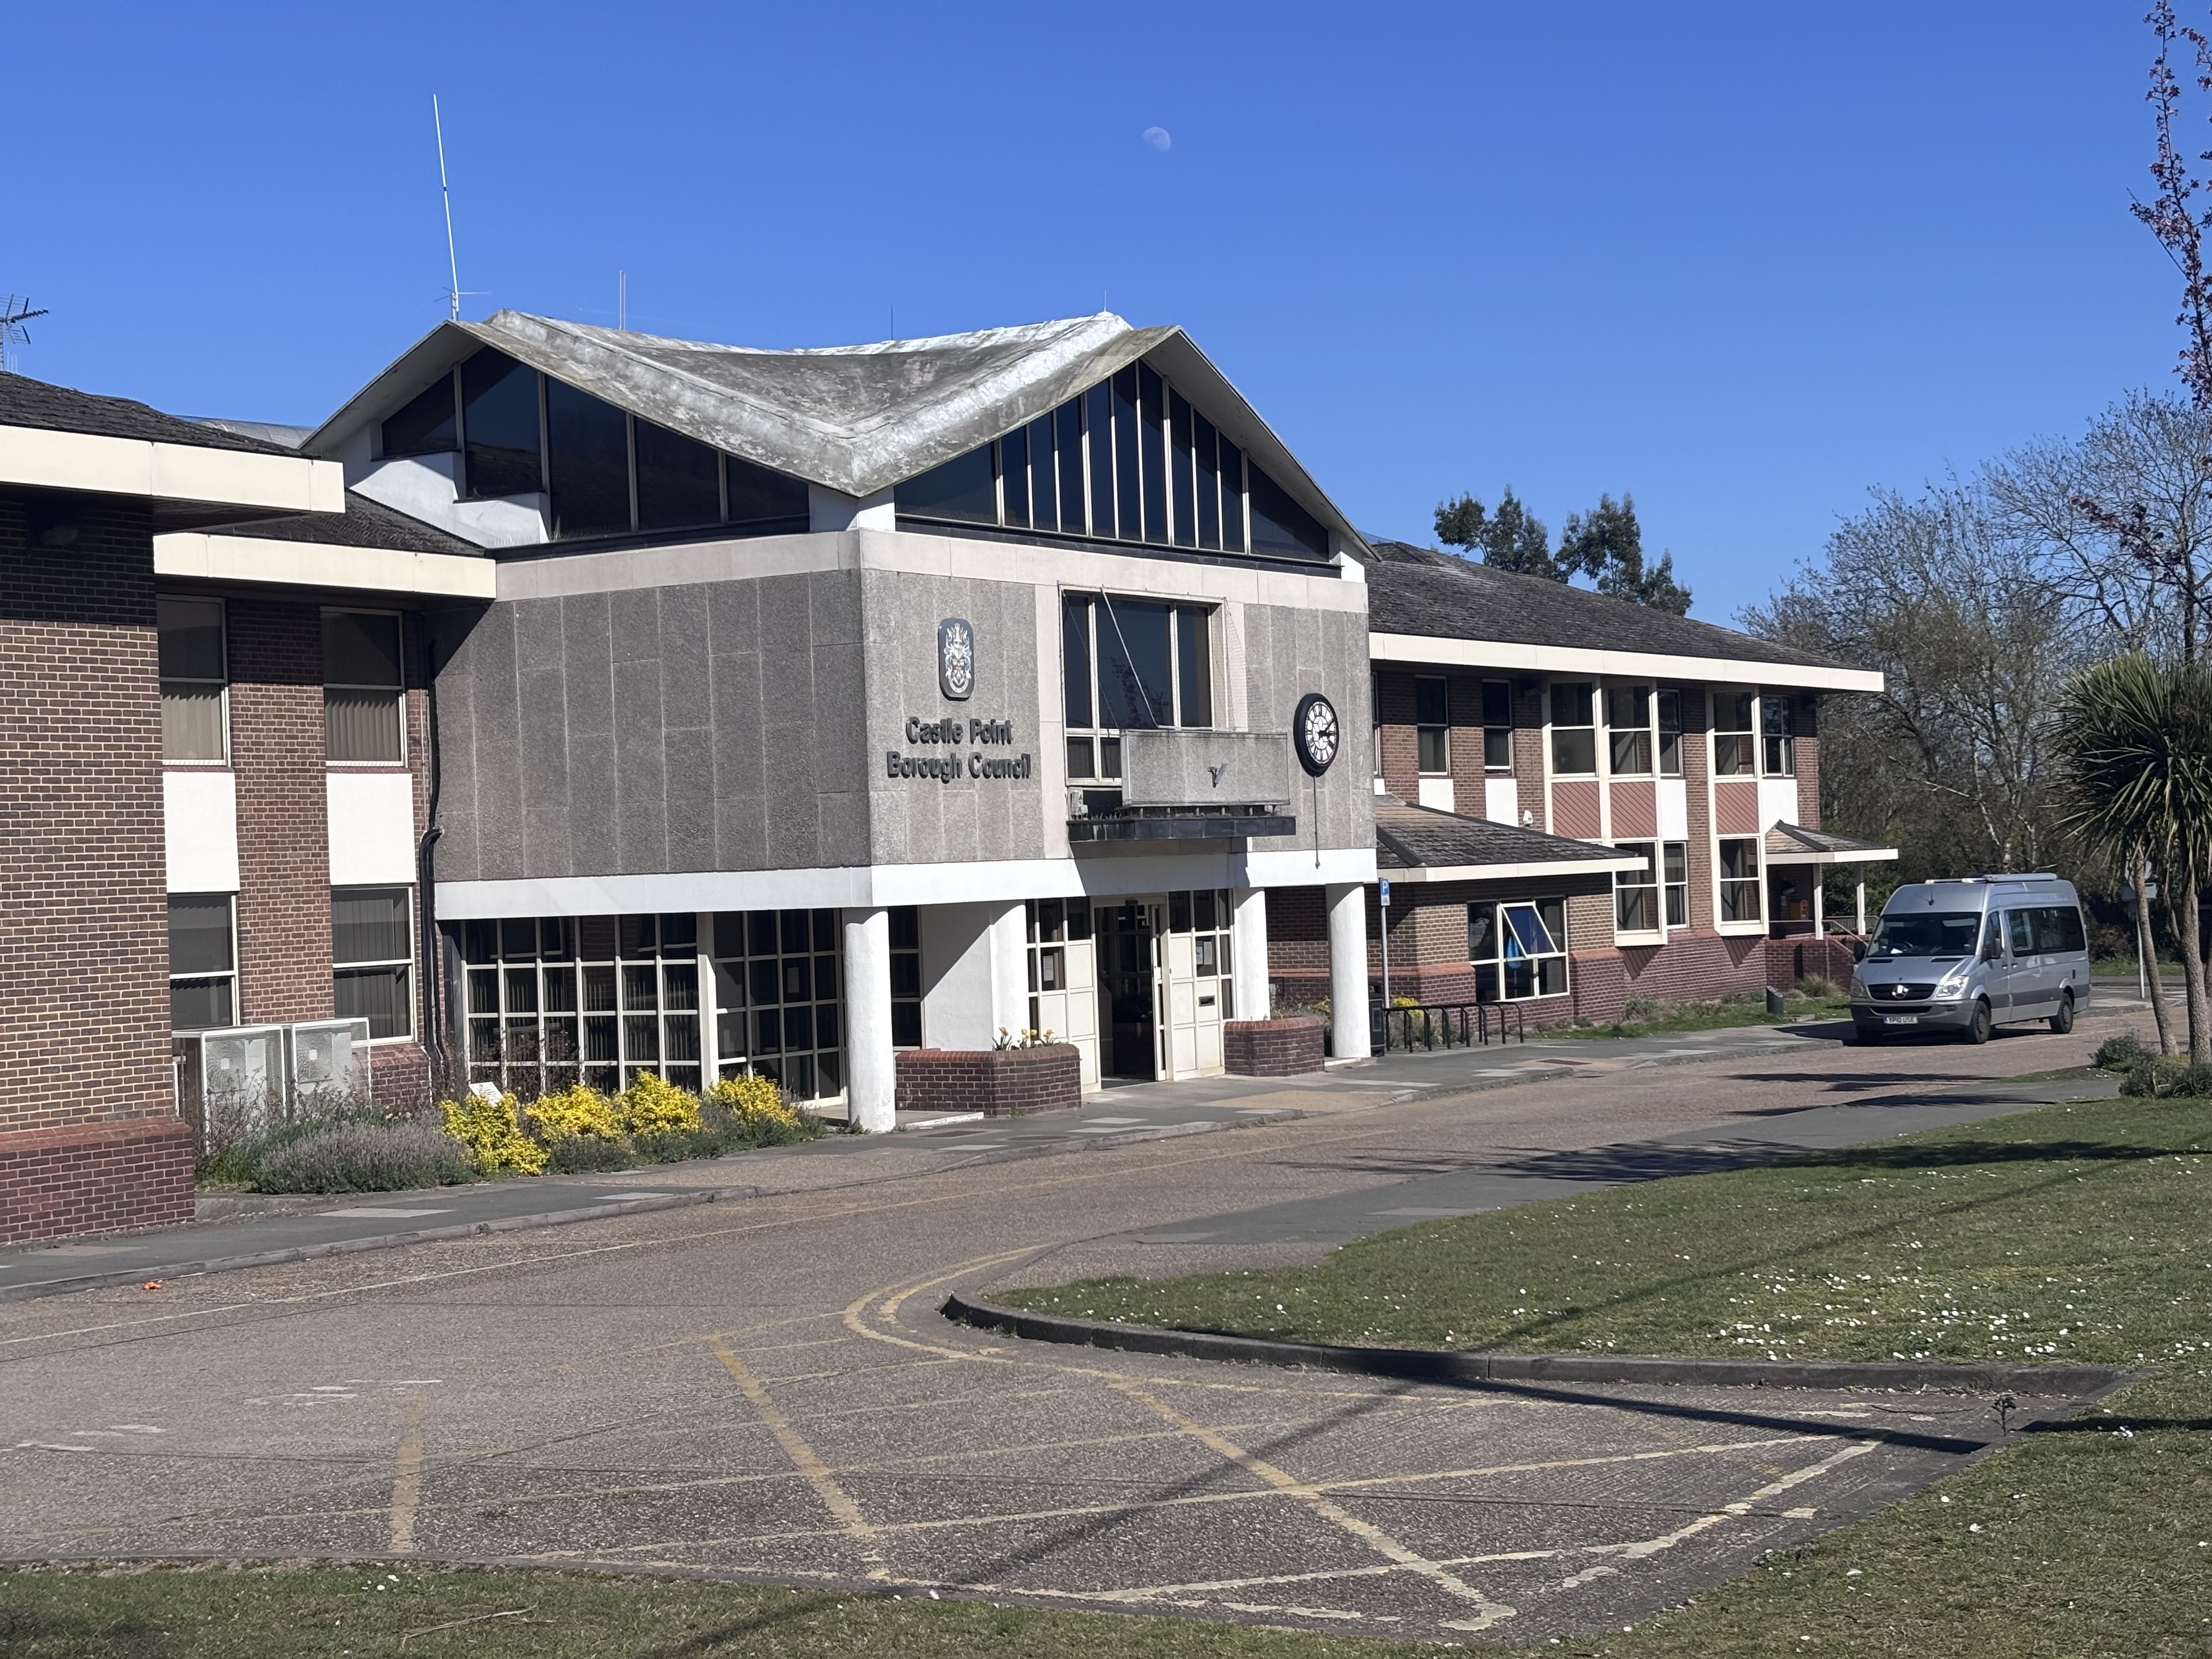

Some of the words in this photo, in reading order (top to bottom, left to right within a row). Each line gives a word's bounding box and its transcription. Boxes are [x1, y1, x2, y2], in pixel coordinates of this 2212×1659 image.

[906, 716, 963, 744] Castle
[969, 718, 1013, 745] Point
[887, 751, 963, 784] Borough
[968, 752, 1031, 779] Council
[1382, 880, 1388, 894] P
